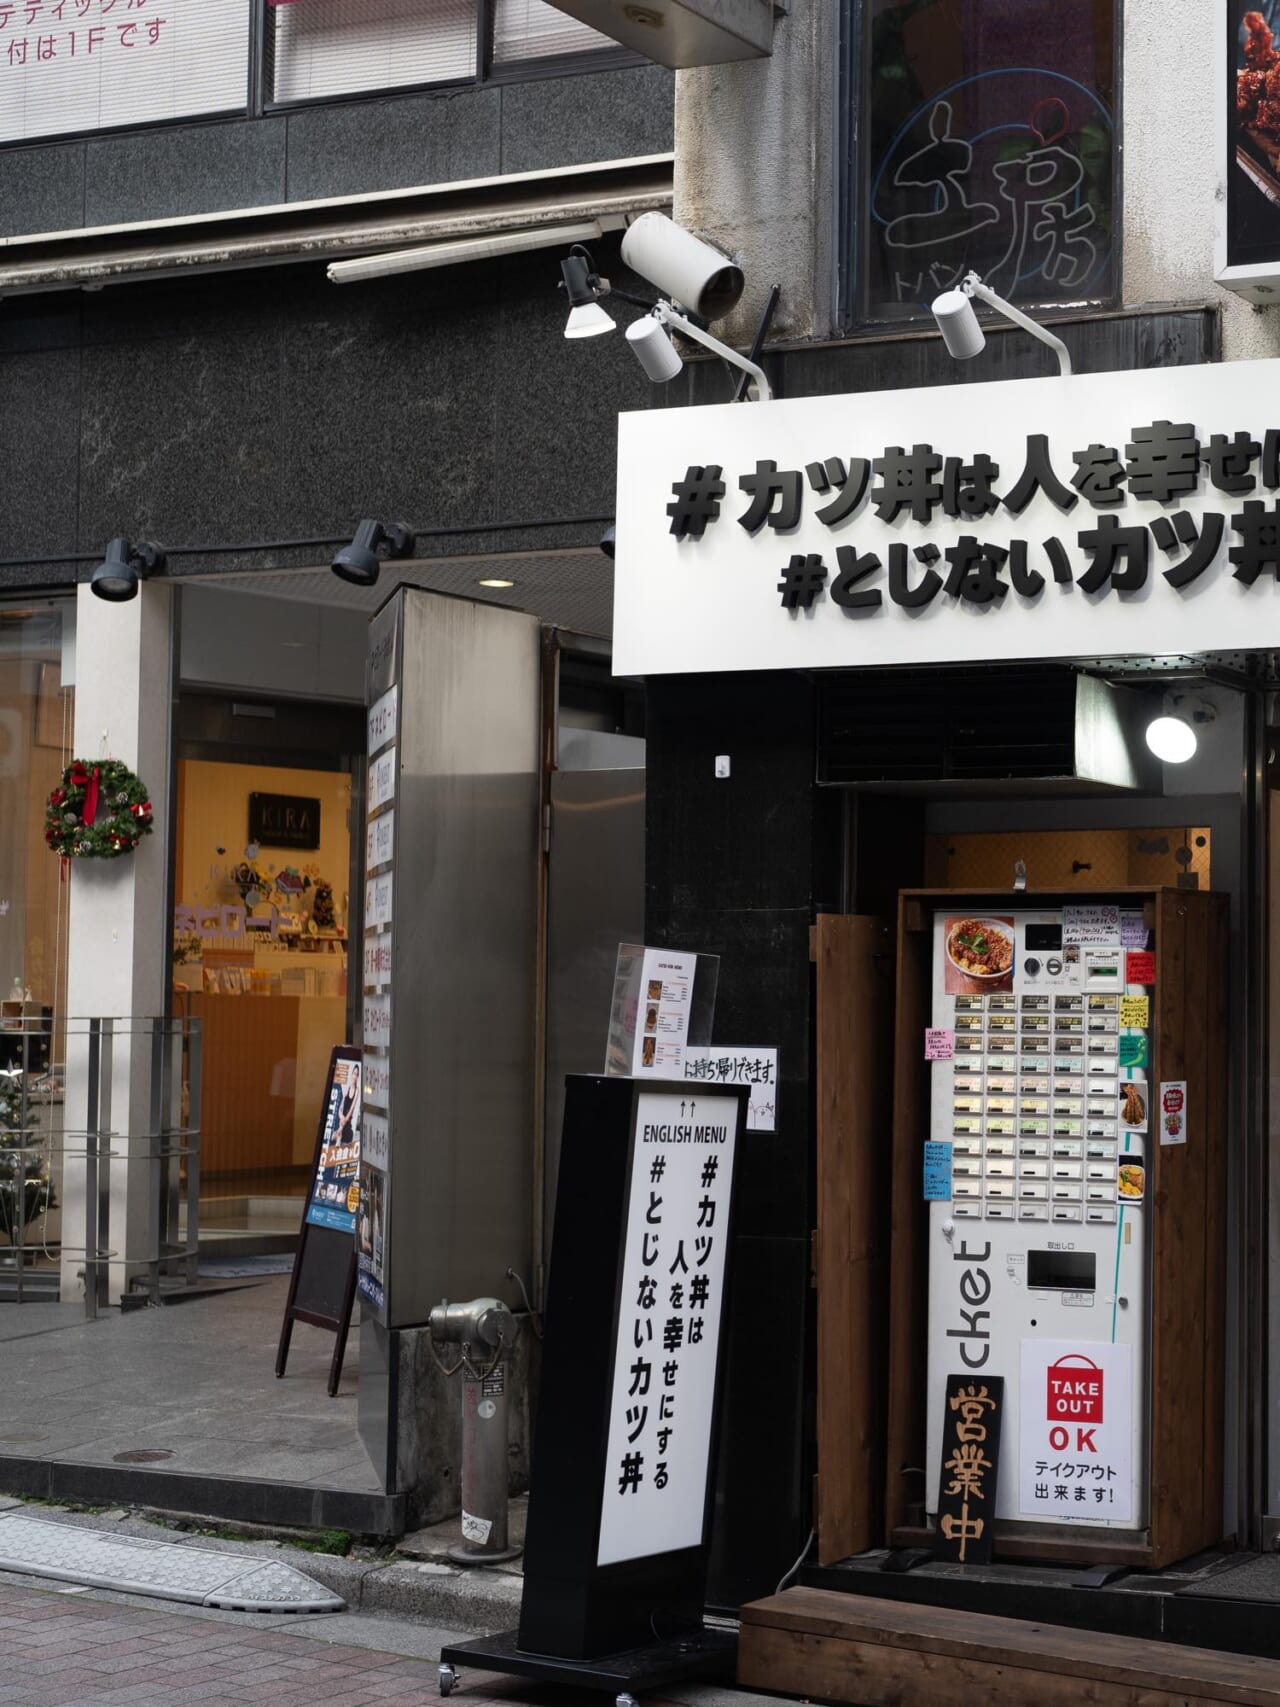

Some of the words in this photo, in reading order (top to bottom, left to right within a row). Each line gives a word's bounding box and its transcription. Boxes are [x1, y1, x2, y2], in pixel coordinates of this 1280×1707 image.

[643, 1125, 691, 1143] ENGLISH
[694, 1126, 727, 1143] MENU
[687, 1155, 719, 1344] #カツ丼は
[618, 1155, 666, 1496] #とじないカツ丼
[653, 1240, 689, 1490] 人を幸せにする
[1051, 1380, 1099, 1396] TAKE
[1056, 1399, 1094, 1414] OUT
[1049, 1426, 1097, 1453] OK
[941, 1385, 996, 1562] 営業中
[1034, 1461, 1118, 1481] テイクアウト
[1035, 1483, 1114, 1503] 出来ます!
